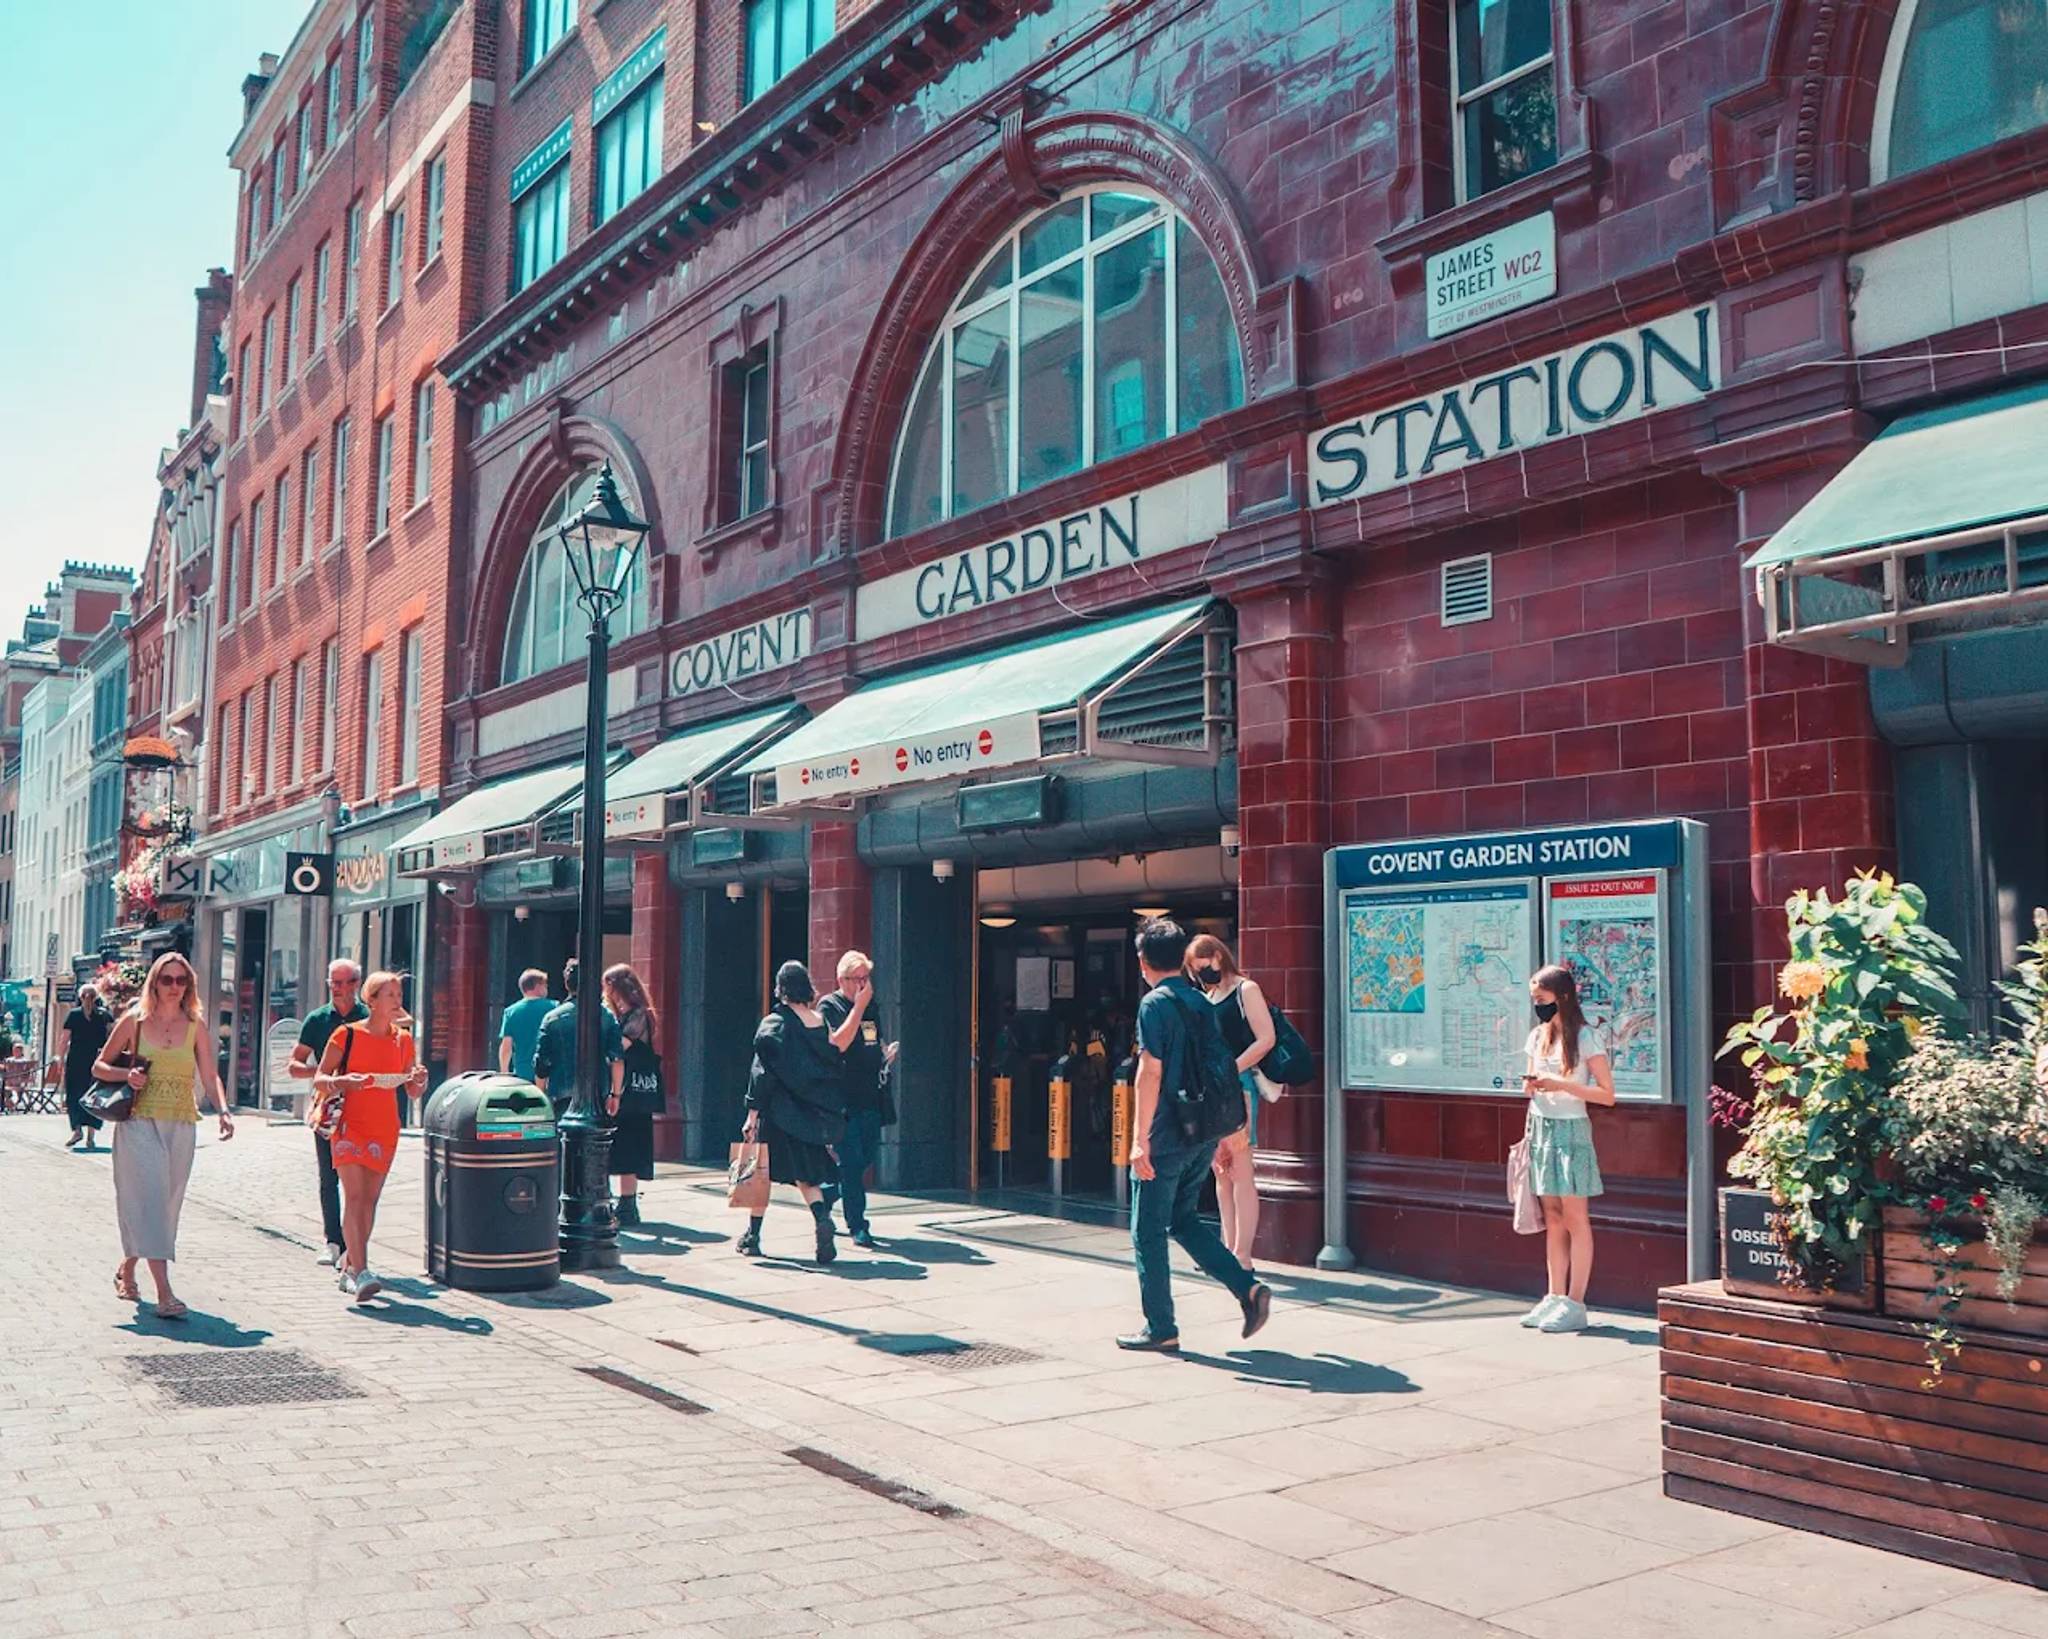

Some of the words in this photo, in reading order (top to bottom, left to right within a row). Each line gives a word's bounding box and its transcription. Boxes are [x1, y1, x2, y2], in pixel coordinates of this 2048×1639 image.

[1437, 243, 1494, 282] JAMES
[1437, 267, 1497, 306] STREET
[1504, 250, 1542, 281] WC2
[1467, 291, 1521, 317] WESTMINSTER
[1316, 306, 1713, 503] STATION
[915, 495, 1142, 619] GARDEN
[671, 607, 811, 695] COVENT
[811, 767, 824, 781] No
[825, 764, 849, 780] entry
[913, 748, 933, 767] No
[937, 740, 973, 762] entry
[1368, 849, 1445, 875] COVENT
[1449, 843, 1534, 869] GARDEN
[1539, 834, 1631, 863] STATION
[1565, 883, 1589, 894] ISSUE
[1601, 881, 1621, 892] OUT
[1622, 879, 1646, 891] NOW
